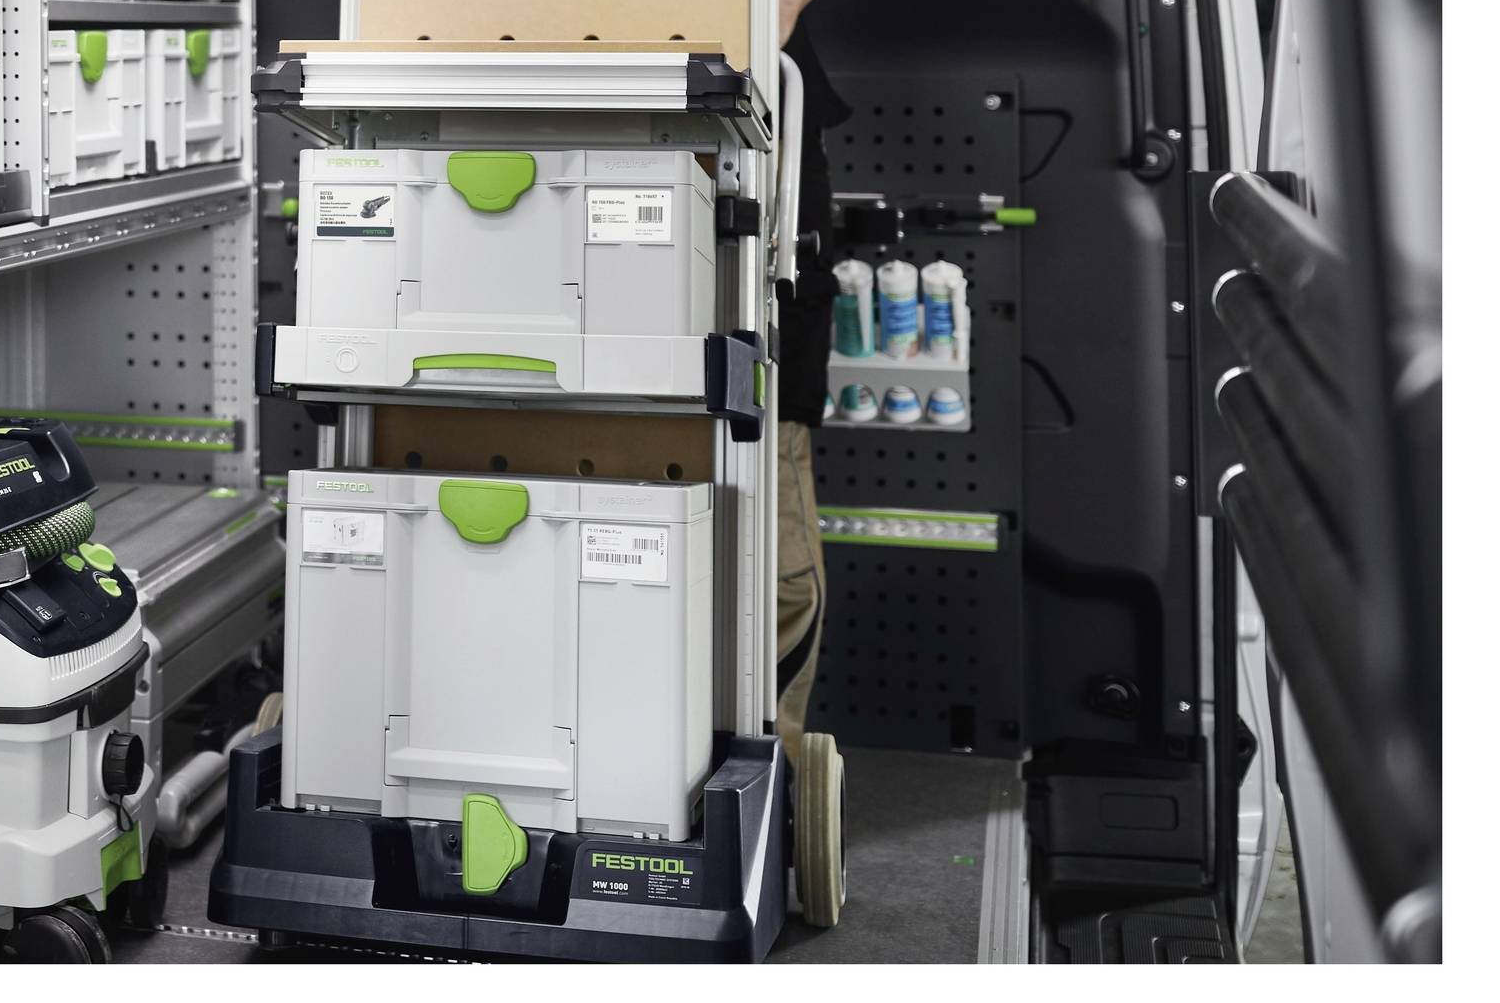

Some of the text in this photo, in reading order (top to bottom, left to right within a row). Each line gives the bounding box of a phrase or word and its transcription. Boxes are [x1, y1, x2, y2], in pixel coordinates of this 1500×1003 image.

[316, 480, 374, 494] FESTOOL
[592, 853, 694, 875] FESTOOL
[592, 880, 629, 891] MW 1000
